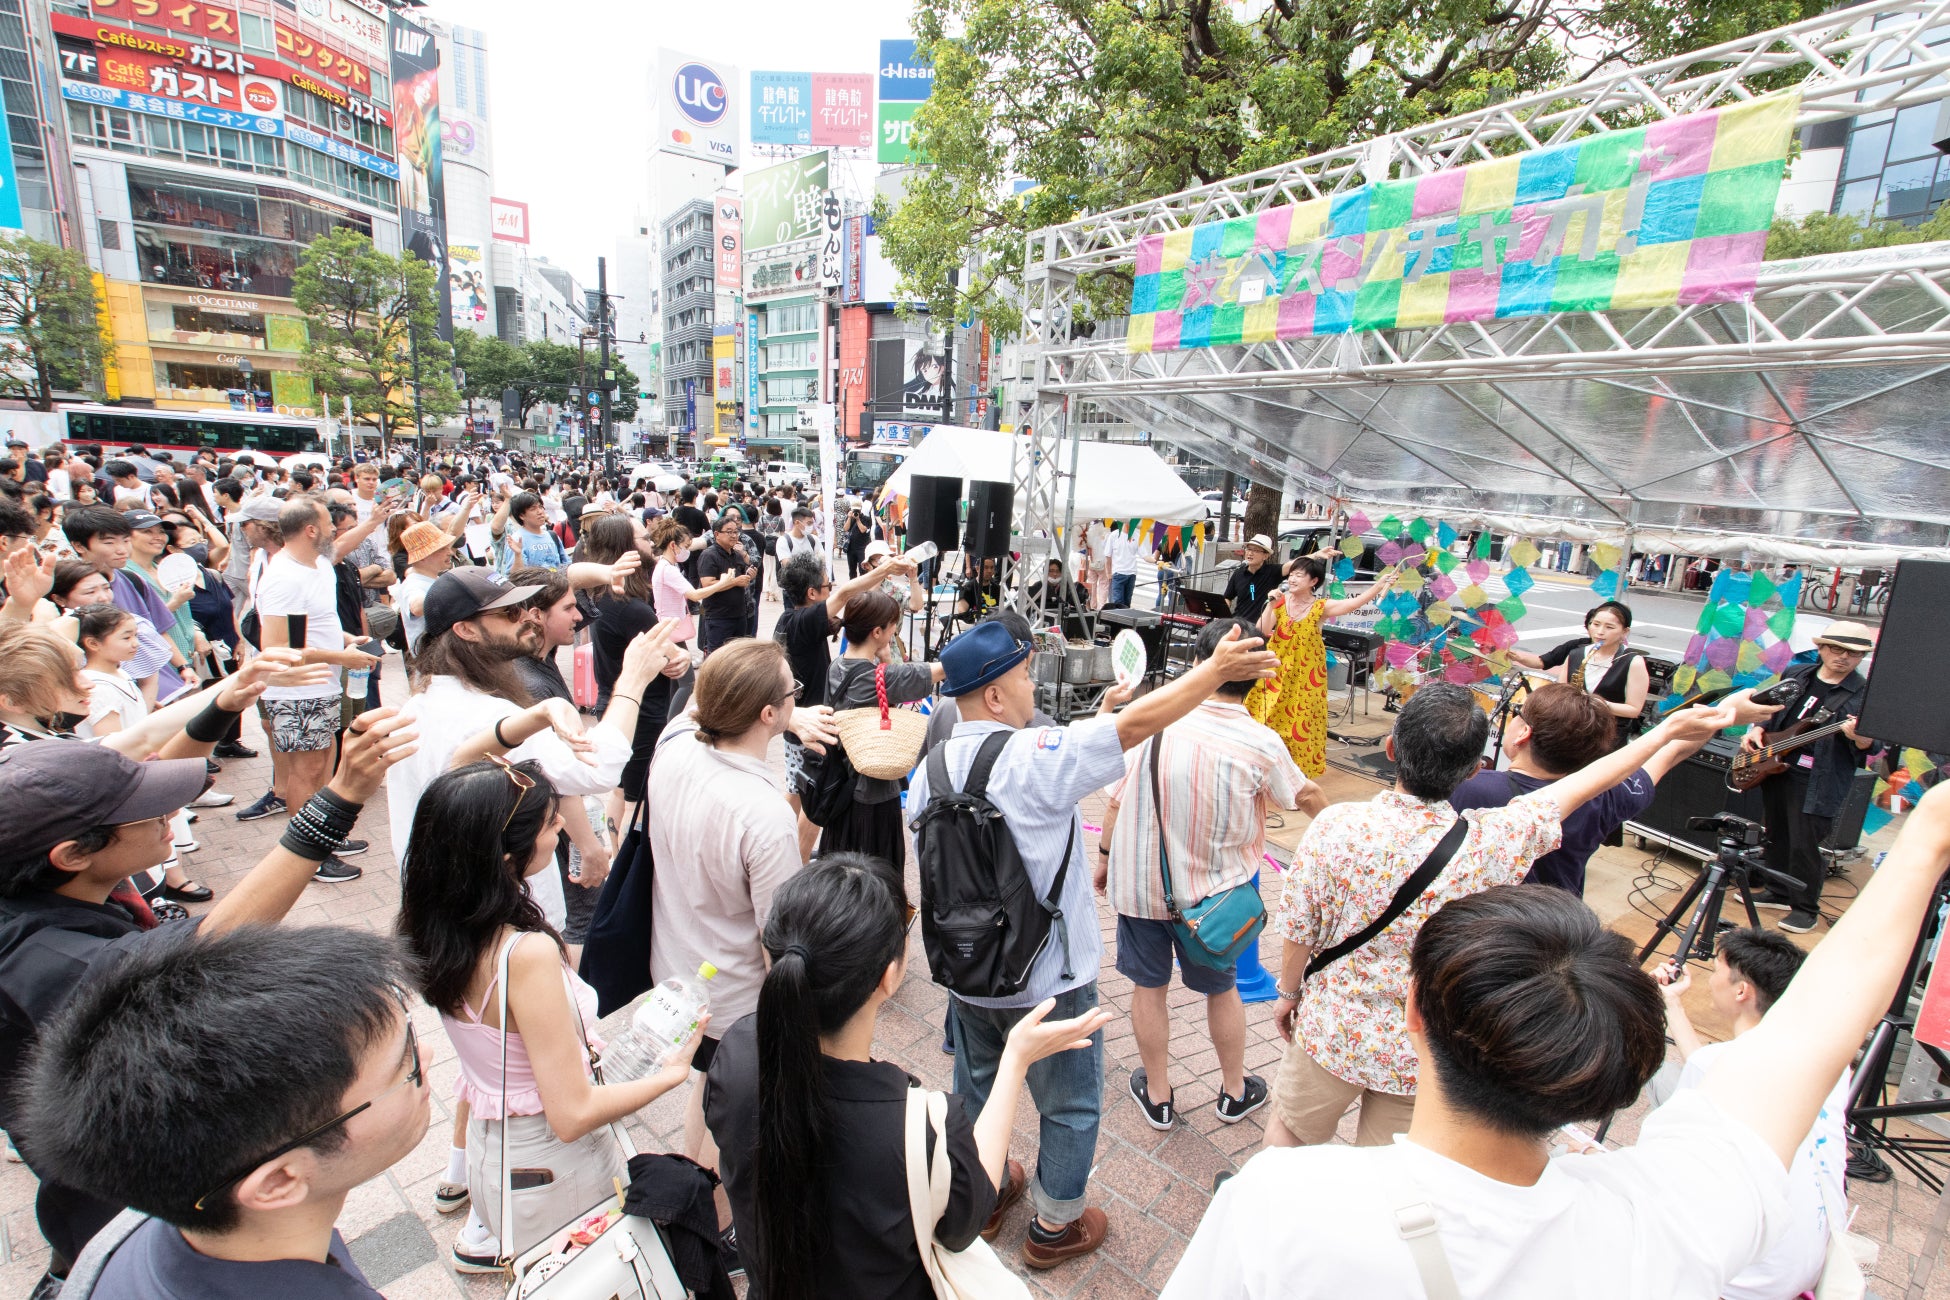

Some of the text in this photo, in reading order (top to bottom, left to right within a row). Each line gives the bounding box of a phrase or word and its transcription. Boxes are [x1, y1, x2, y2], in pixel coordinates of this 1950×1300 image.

[95, 0, 234, 34] ライス
[275, 26, 366, 85] コンタクト
[395, 27, 431, 57] LADY
[60, 50, 97, 72] 7F
[105, 59, 145, 77] Café
[190, 44, 255, 74] ガスト
[149, 66, 233, 104] ガスト
[763, 86, 799, 105] 龍角散
[825, 88, 861, 106] 龍角散
[127, 93, 249, 126] 英会話イーオン
[348, 95, 387, 125] ガスト
[709, 140, 733, 154] VISA
[744, 160, 827, 234] アイジー
[822, 190, 843, 284] もんじゃ
[188, 295, 259, 311] L'OCCITANE
[718, 367, 731, 388] 薬
